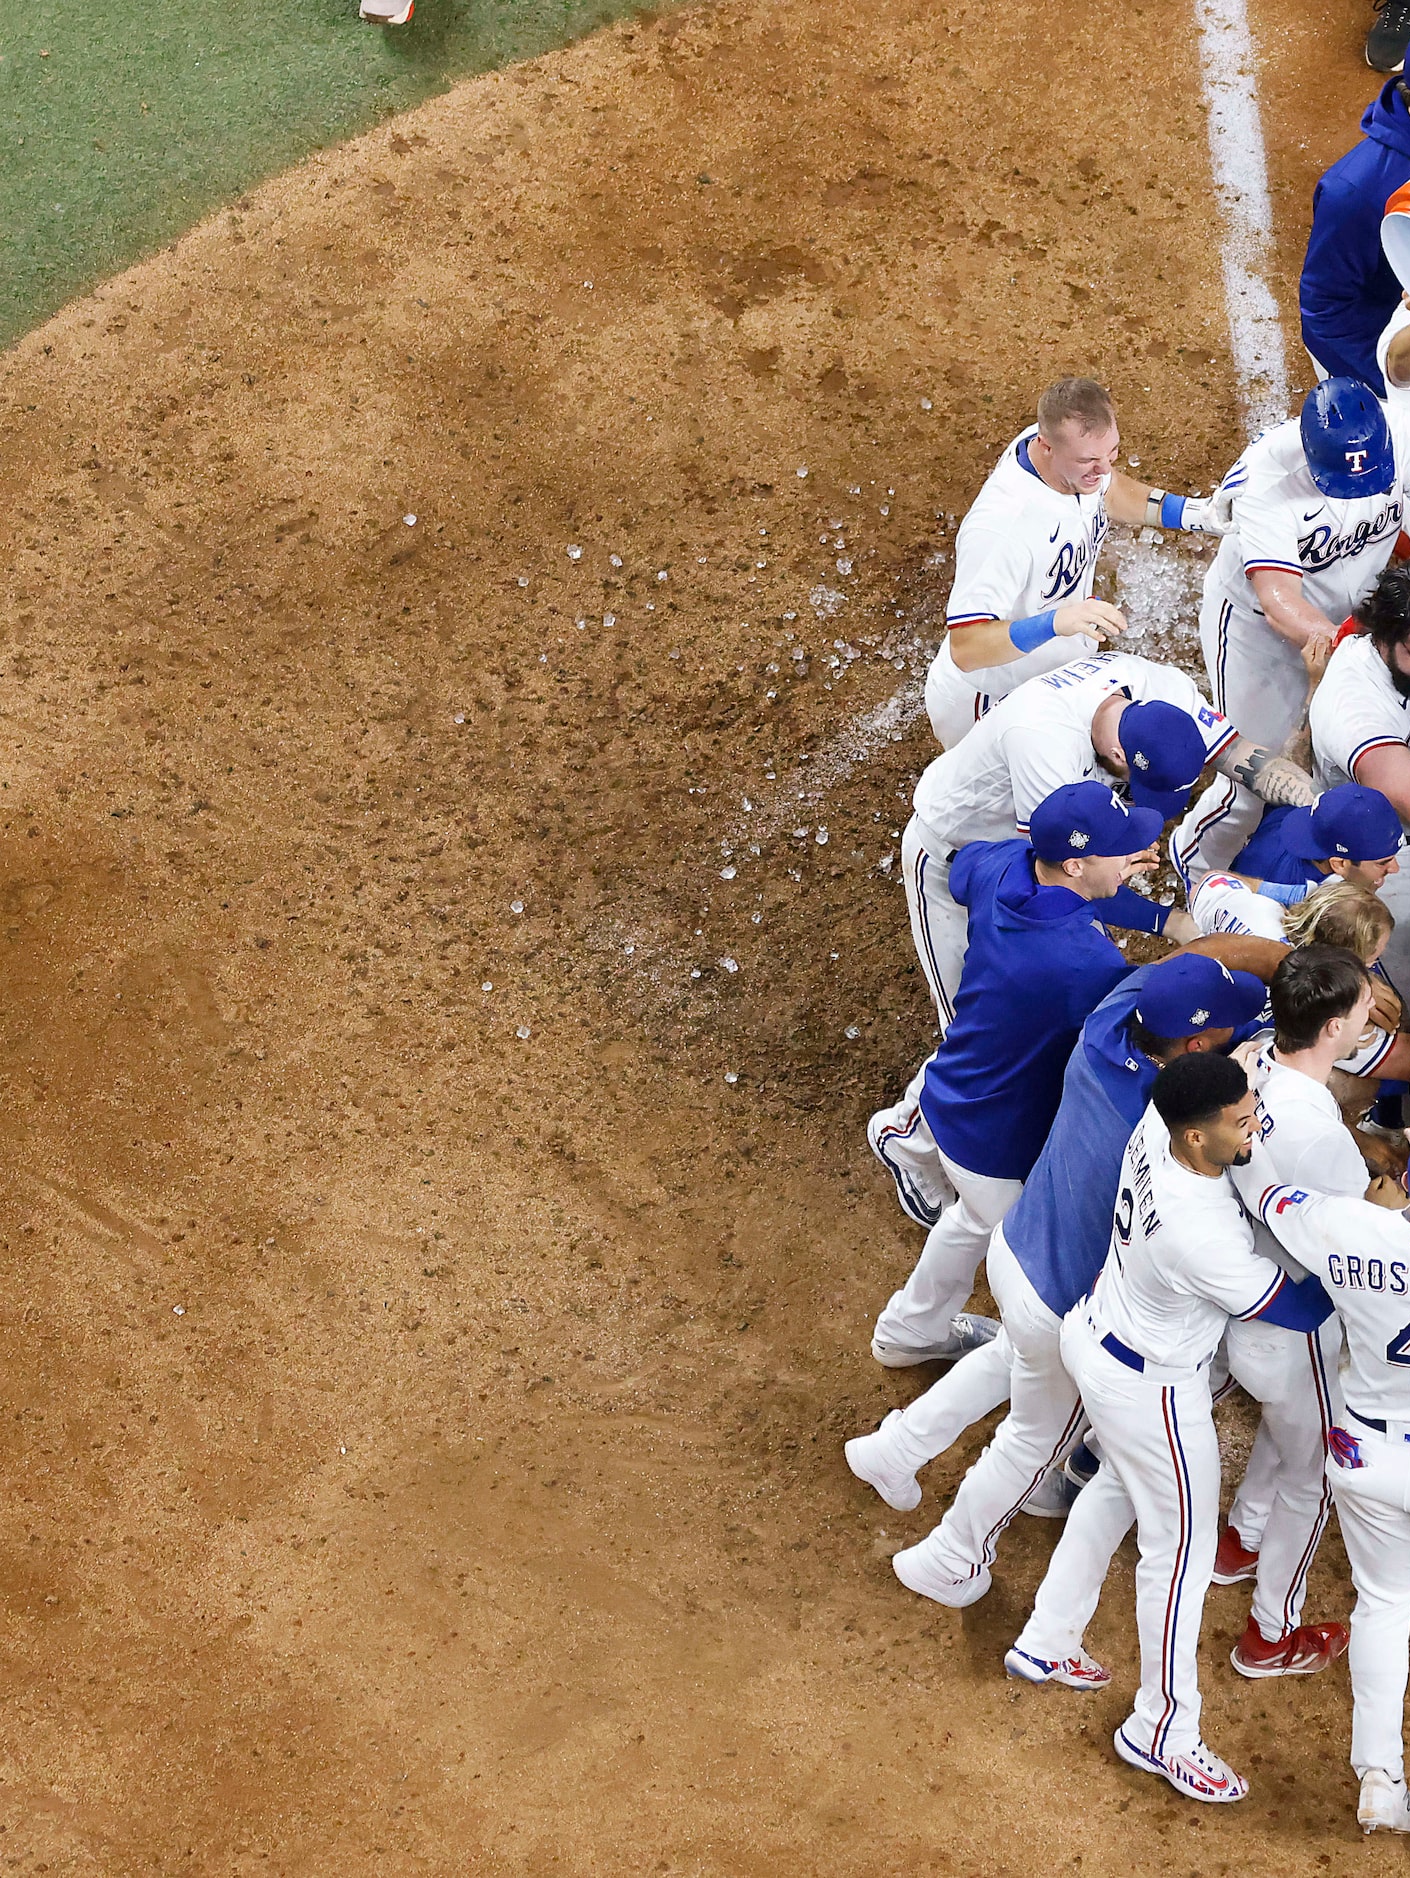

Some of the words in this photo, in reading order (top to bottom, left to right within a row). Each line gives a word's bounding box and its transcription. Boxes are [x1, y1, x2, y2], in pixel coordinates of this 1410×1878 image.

[1345, 450, 1369, 473] T
[1040, 652, 1119, 690] HEIM
[1128, 1123, 1163, 1241] SEMIEN
